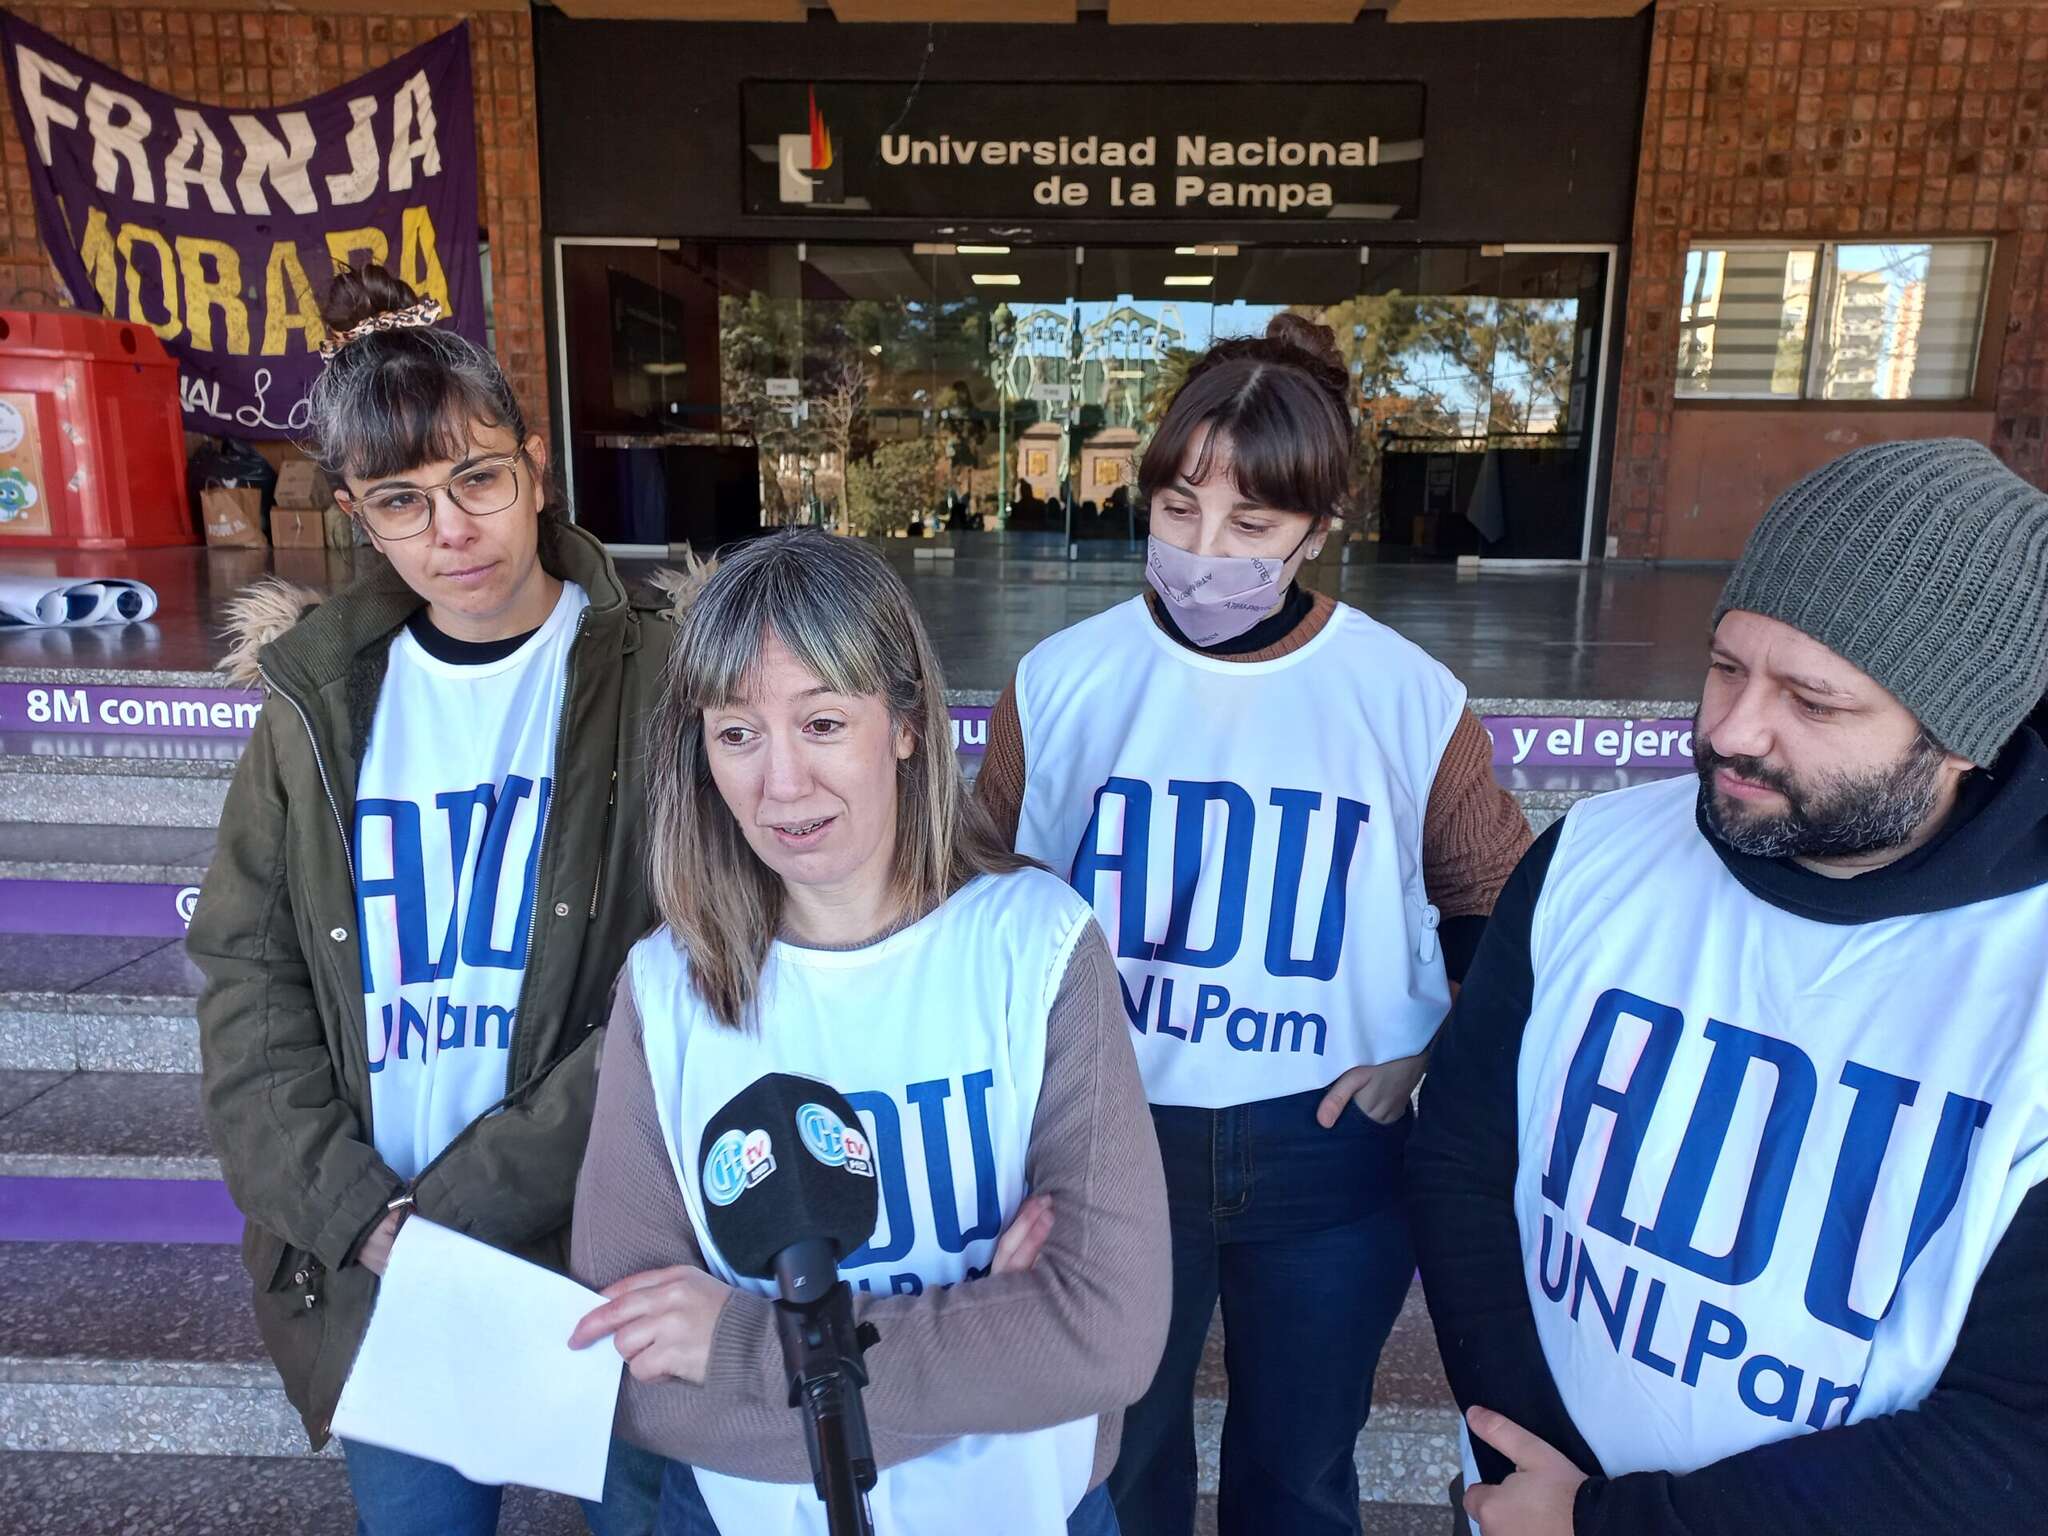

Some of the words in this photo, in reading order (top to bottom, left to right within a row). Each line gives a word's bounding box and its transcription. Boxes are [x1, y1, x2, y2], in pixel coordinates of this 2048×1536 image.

[15, 44, 442, 216] FRANJA
[880, 134, 1156, 167] Universidad
[1176, 134, 1380, 167] Nacional
[1033, 175, 1089, 206] de
[1176, 175, 1334, 213] Pampa
[26, 689, 90, 724] 8M
[1512, 728, 1539, 764] y
[1546, 719, 1585, 756] el
[1070, 776, 1371, 982] ADU
[1117, 968, 1327, 1056] NLPam
[838, 1069, 994, 1269] DU
[1541, 988, 1993, 1341] ADU
